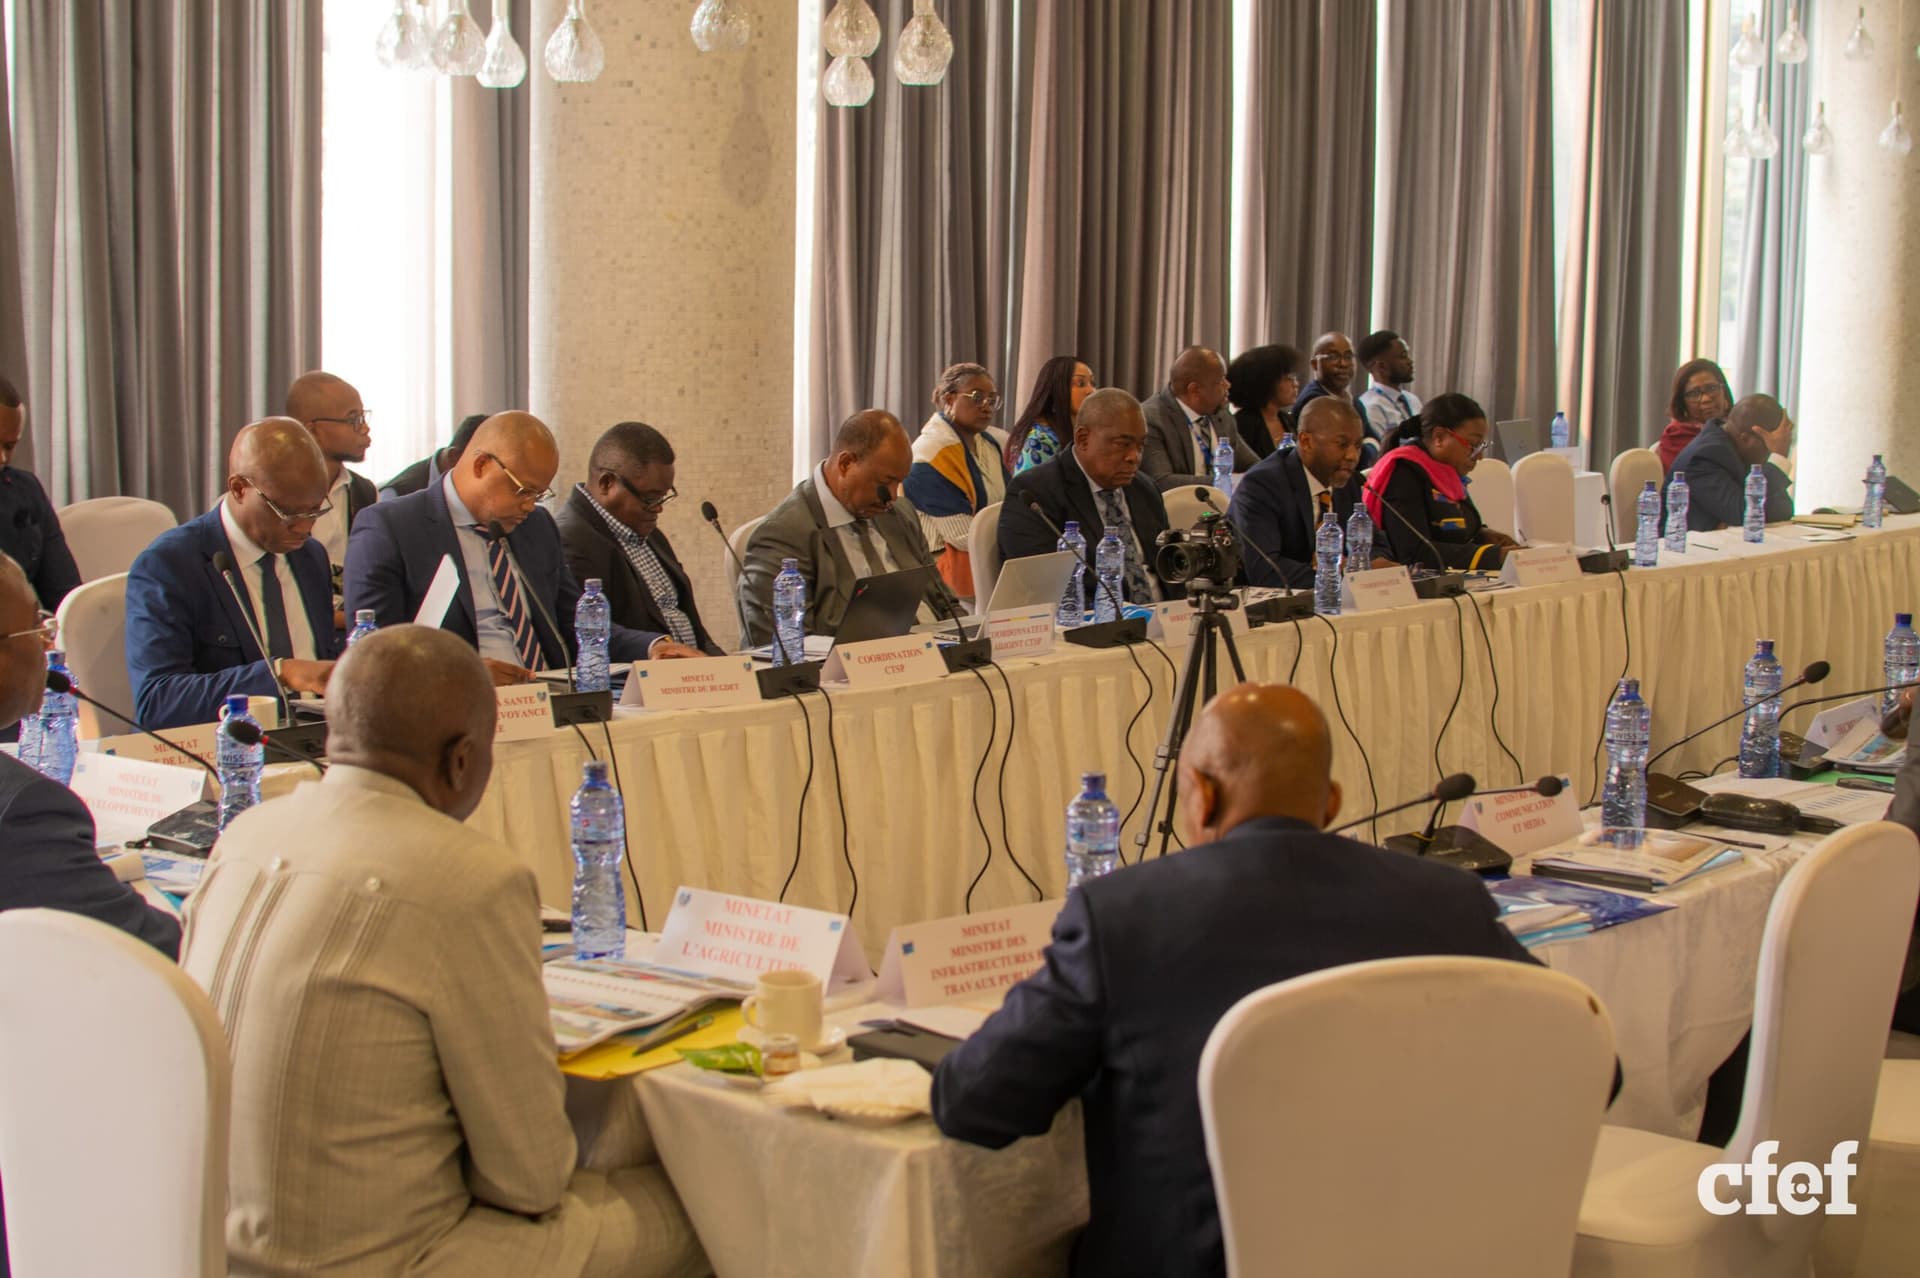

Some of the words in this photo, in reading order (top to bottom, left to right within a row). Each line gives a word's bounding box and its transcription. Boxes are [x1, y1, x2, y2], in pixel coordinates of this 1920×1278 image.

[857, 648, 923, 664] COORDINATION
[884, 664, 905, 674] CTSP
[681, 674, 715, 682] MINETAT
[660, 686, 696, 695] MINISTRE
[504, 696, 535, 706] SANTE
[1496, 799, 1555, 822] COMMUNICATION
[1523, 818, 1546, 831] MEDIA
[725, 899, 793, 925] MINETAT
[704, 920, 776, 947] MINISTRE
[779, 934, 801, 951] DE
[962, 920, 1011, 936] MINETAT
[952, 939, 1002, 957] MINISTRE
[1006, 936, 1027, 948] DES
[930, 951, 1034, 980] INFRASTRUCTURES
[944, 977, 998, 996] TRAVAUX
